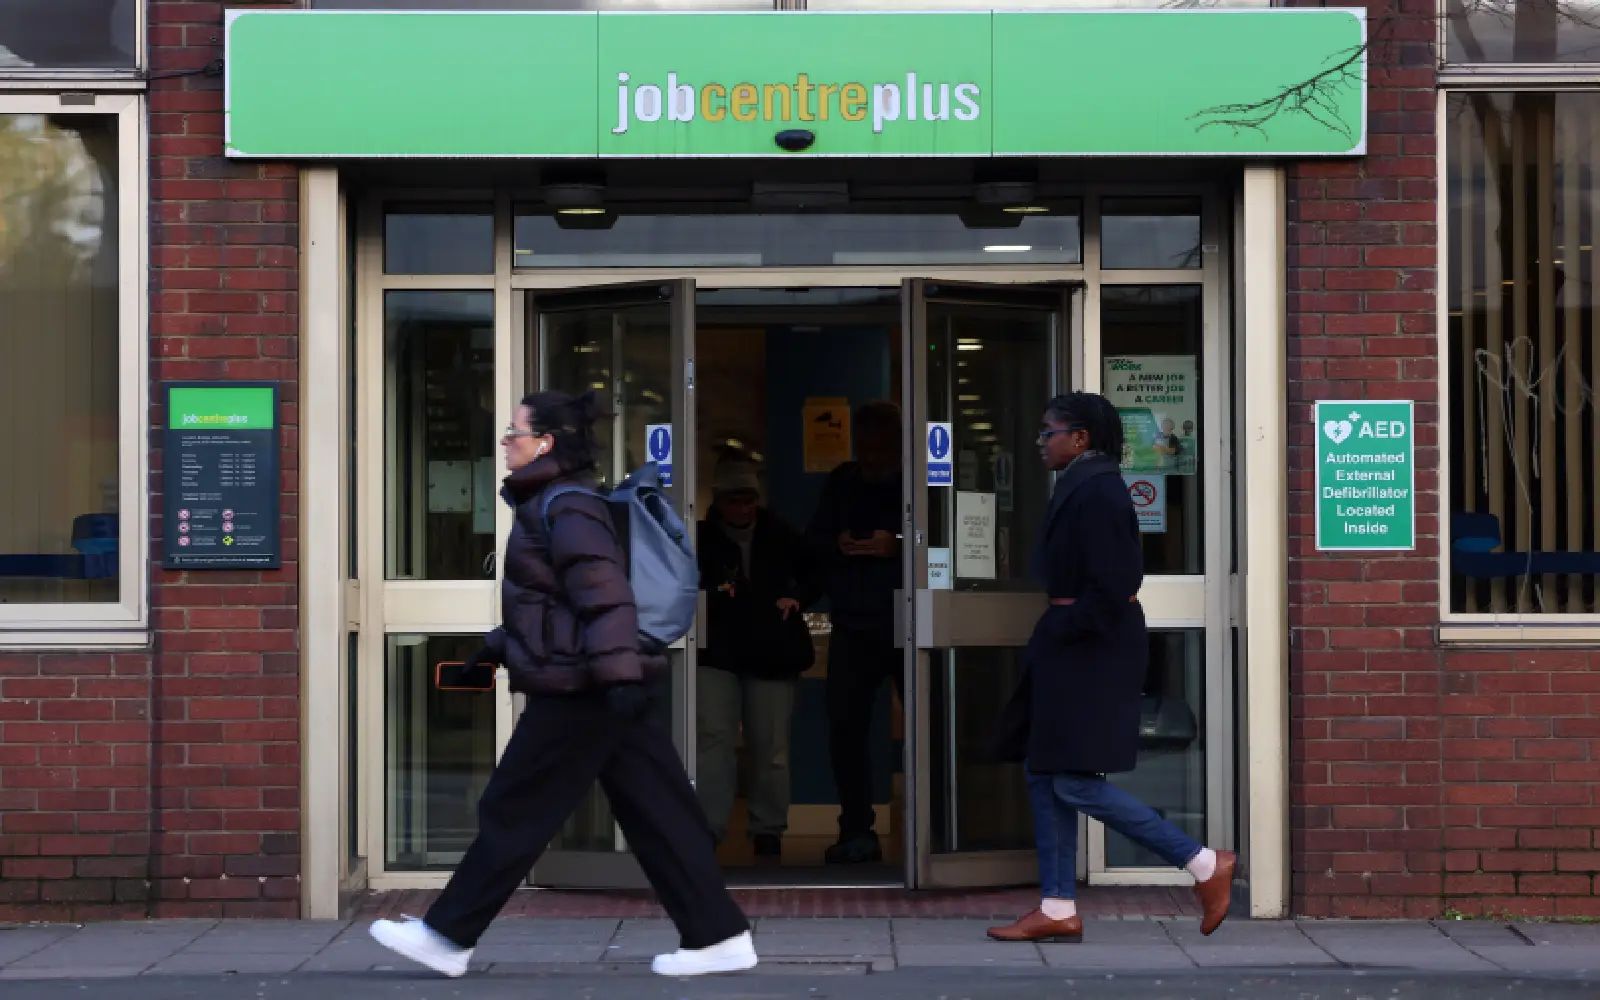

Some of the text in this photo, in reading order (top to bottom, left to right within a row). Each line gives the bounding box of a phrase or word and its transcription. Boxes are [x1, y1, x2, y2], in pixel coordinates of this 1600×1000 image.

[611, 71, 981, 134] jobcentreplus
[1166, 374, 1186, 382] JOB
[1165, 384, 1186, 394] JOB
[1358, 420, 1406, 439] AED
[1325, 451, 1405, 464] Automated
[1335, 469, 1395, 481] External
[1322, 486, 1409, 499] Defibrillator
[1336, 504, 1395, 517] Located
[1344, 521, 1389, 535] Inside
